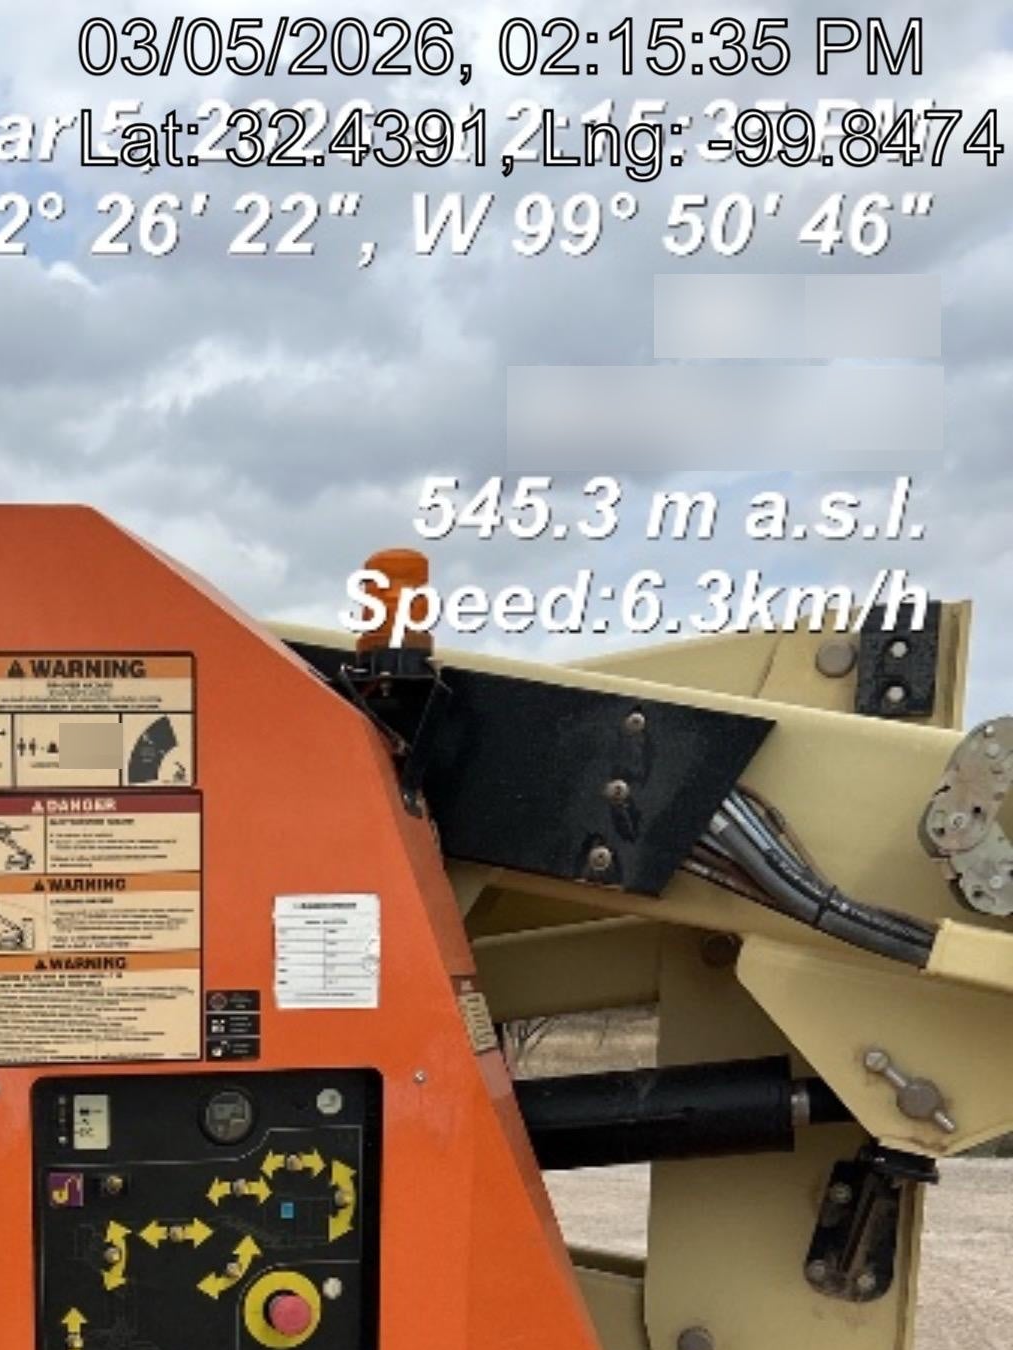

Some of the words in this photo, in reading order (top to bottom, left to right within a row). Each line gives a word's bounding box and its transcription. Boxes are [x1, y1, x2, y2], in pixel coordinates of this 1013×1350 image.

[30, 660, 146, 679] WARNING
[46, 798, 117, 813] DANGER
[48, 878, 127, 892] WARNING
[49, 957, 128, 971] WARNING
